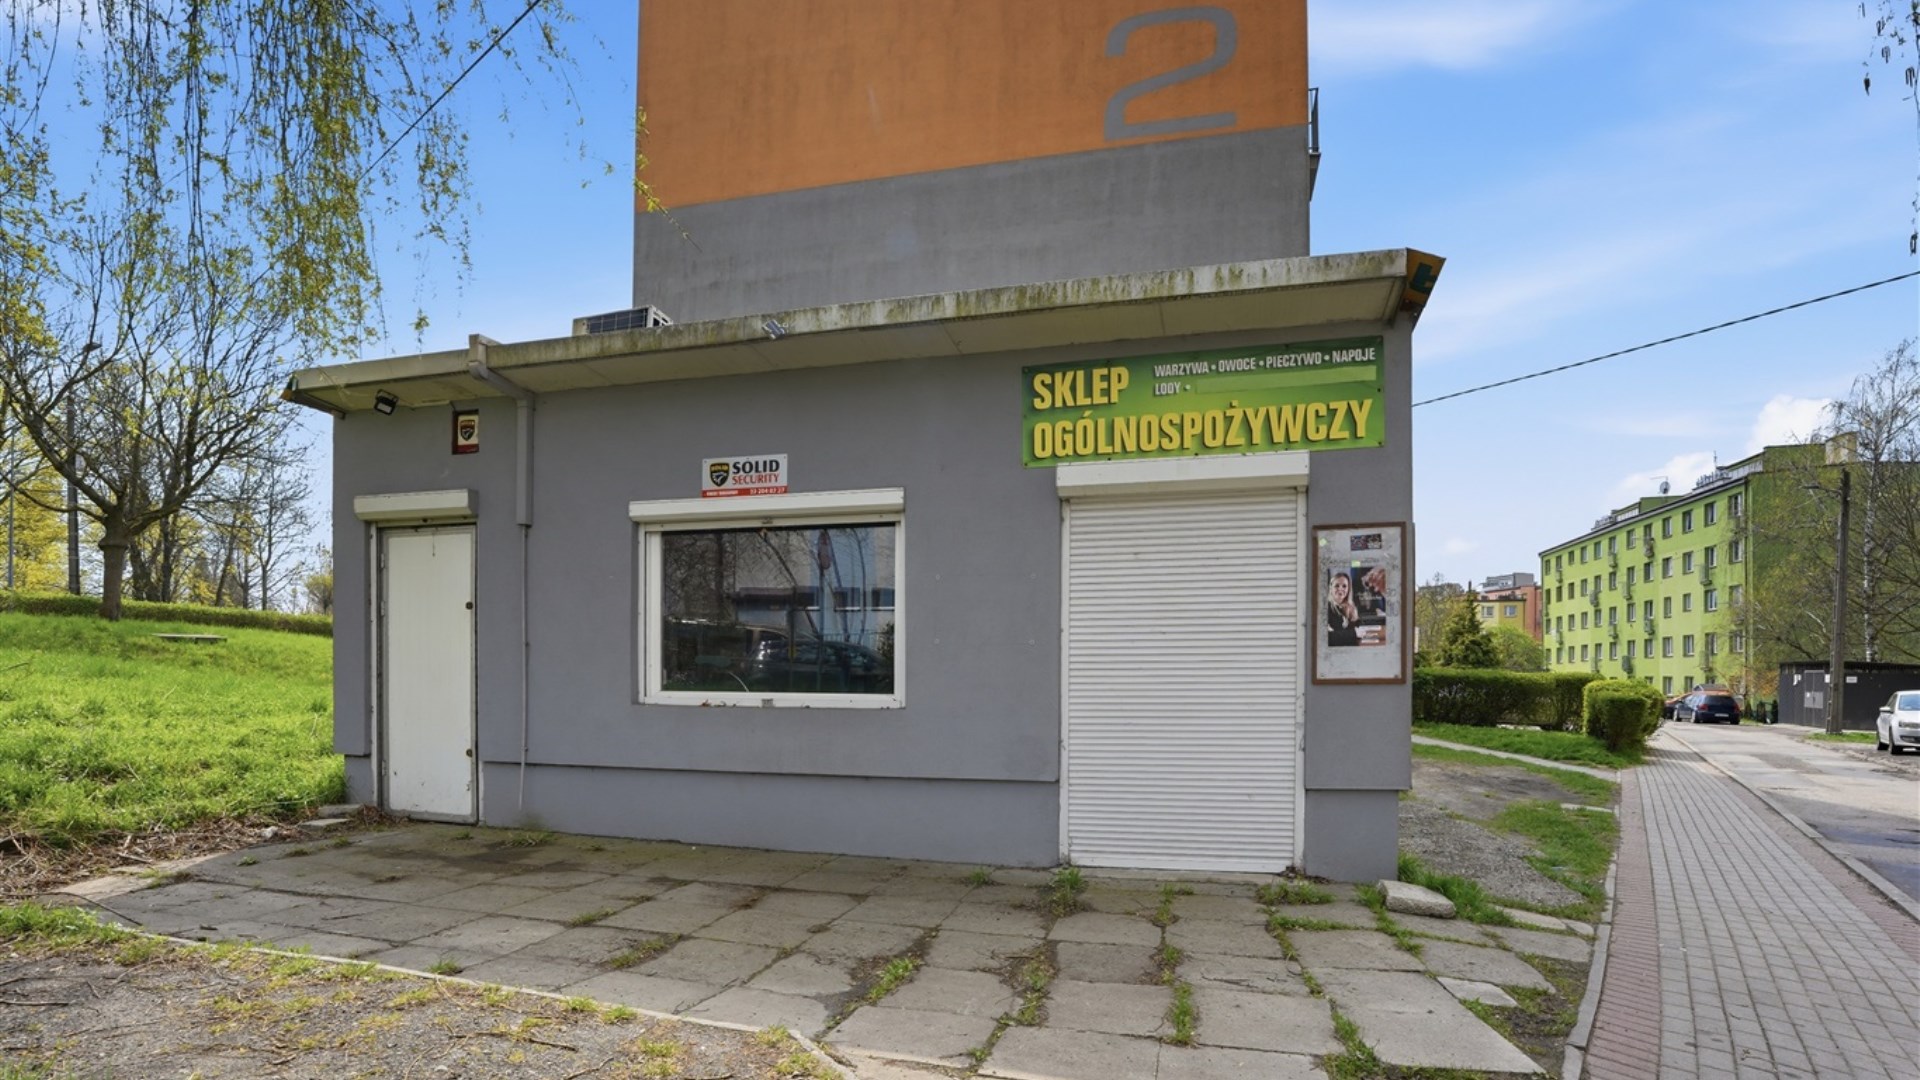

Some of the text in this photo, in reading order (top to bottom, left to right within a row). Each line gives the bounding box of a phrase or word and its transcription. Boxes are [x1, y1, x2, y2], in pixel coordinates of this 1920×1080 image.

[1104, 6, 1238, 141] 2
[1154, 347, 1376, 377] WARZYWA OWOCE PIECZYWO NAPOJE
[1032, 366, 1130, 410] SKLEP
[1154, 382, 1181, 396] LODY
[1032, 398, 1373, 459] OGÓLNOSPOŻYWCZY
[732, 459, 780, 474] SOLID
[732, 473, 779, 485] SECURITY
